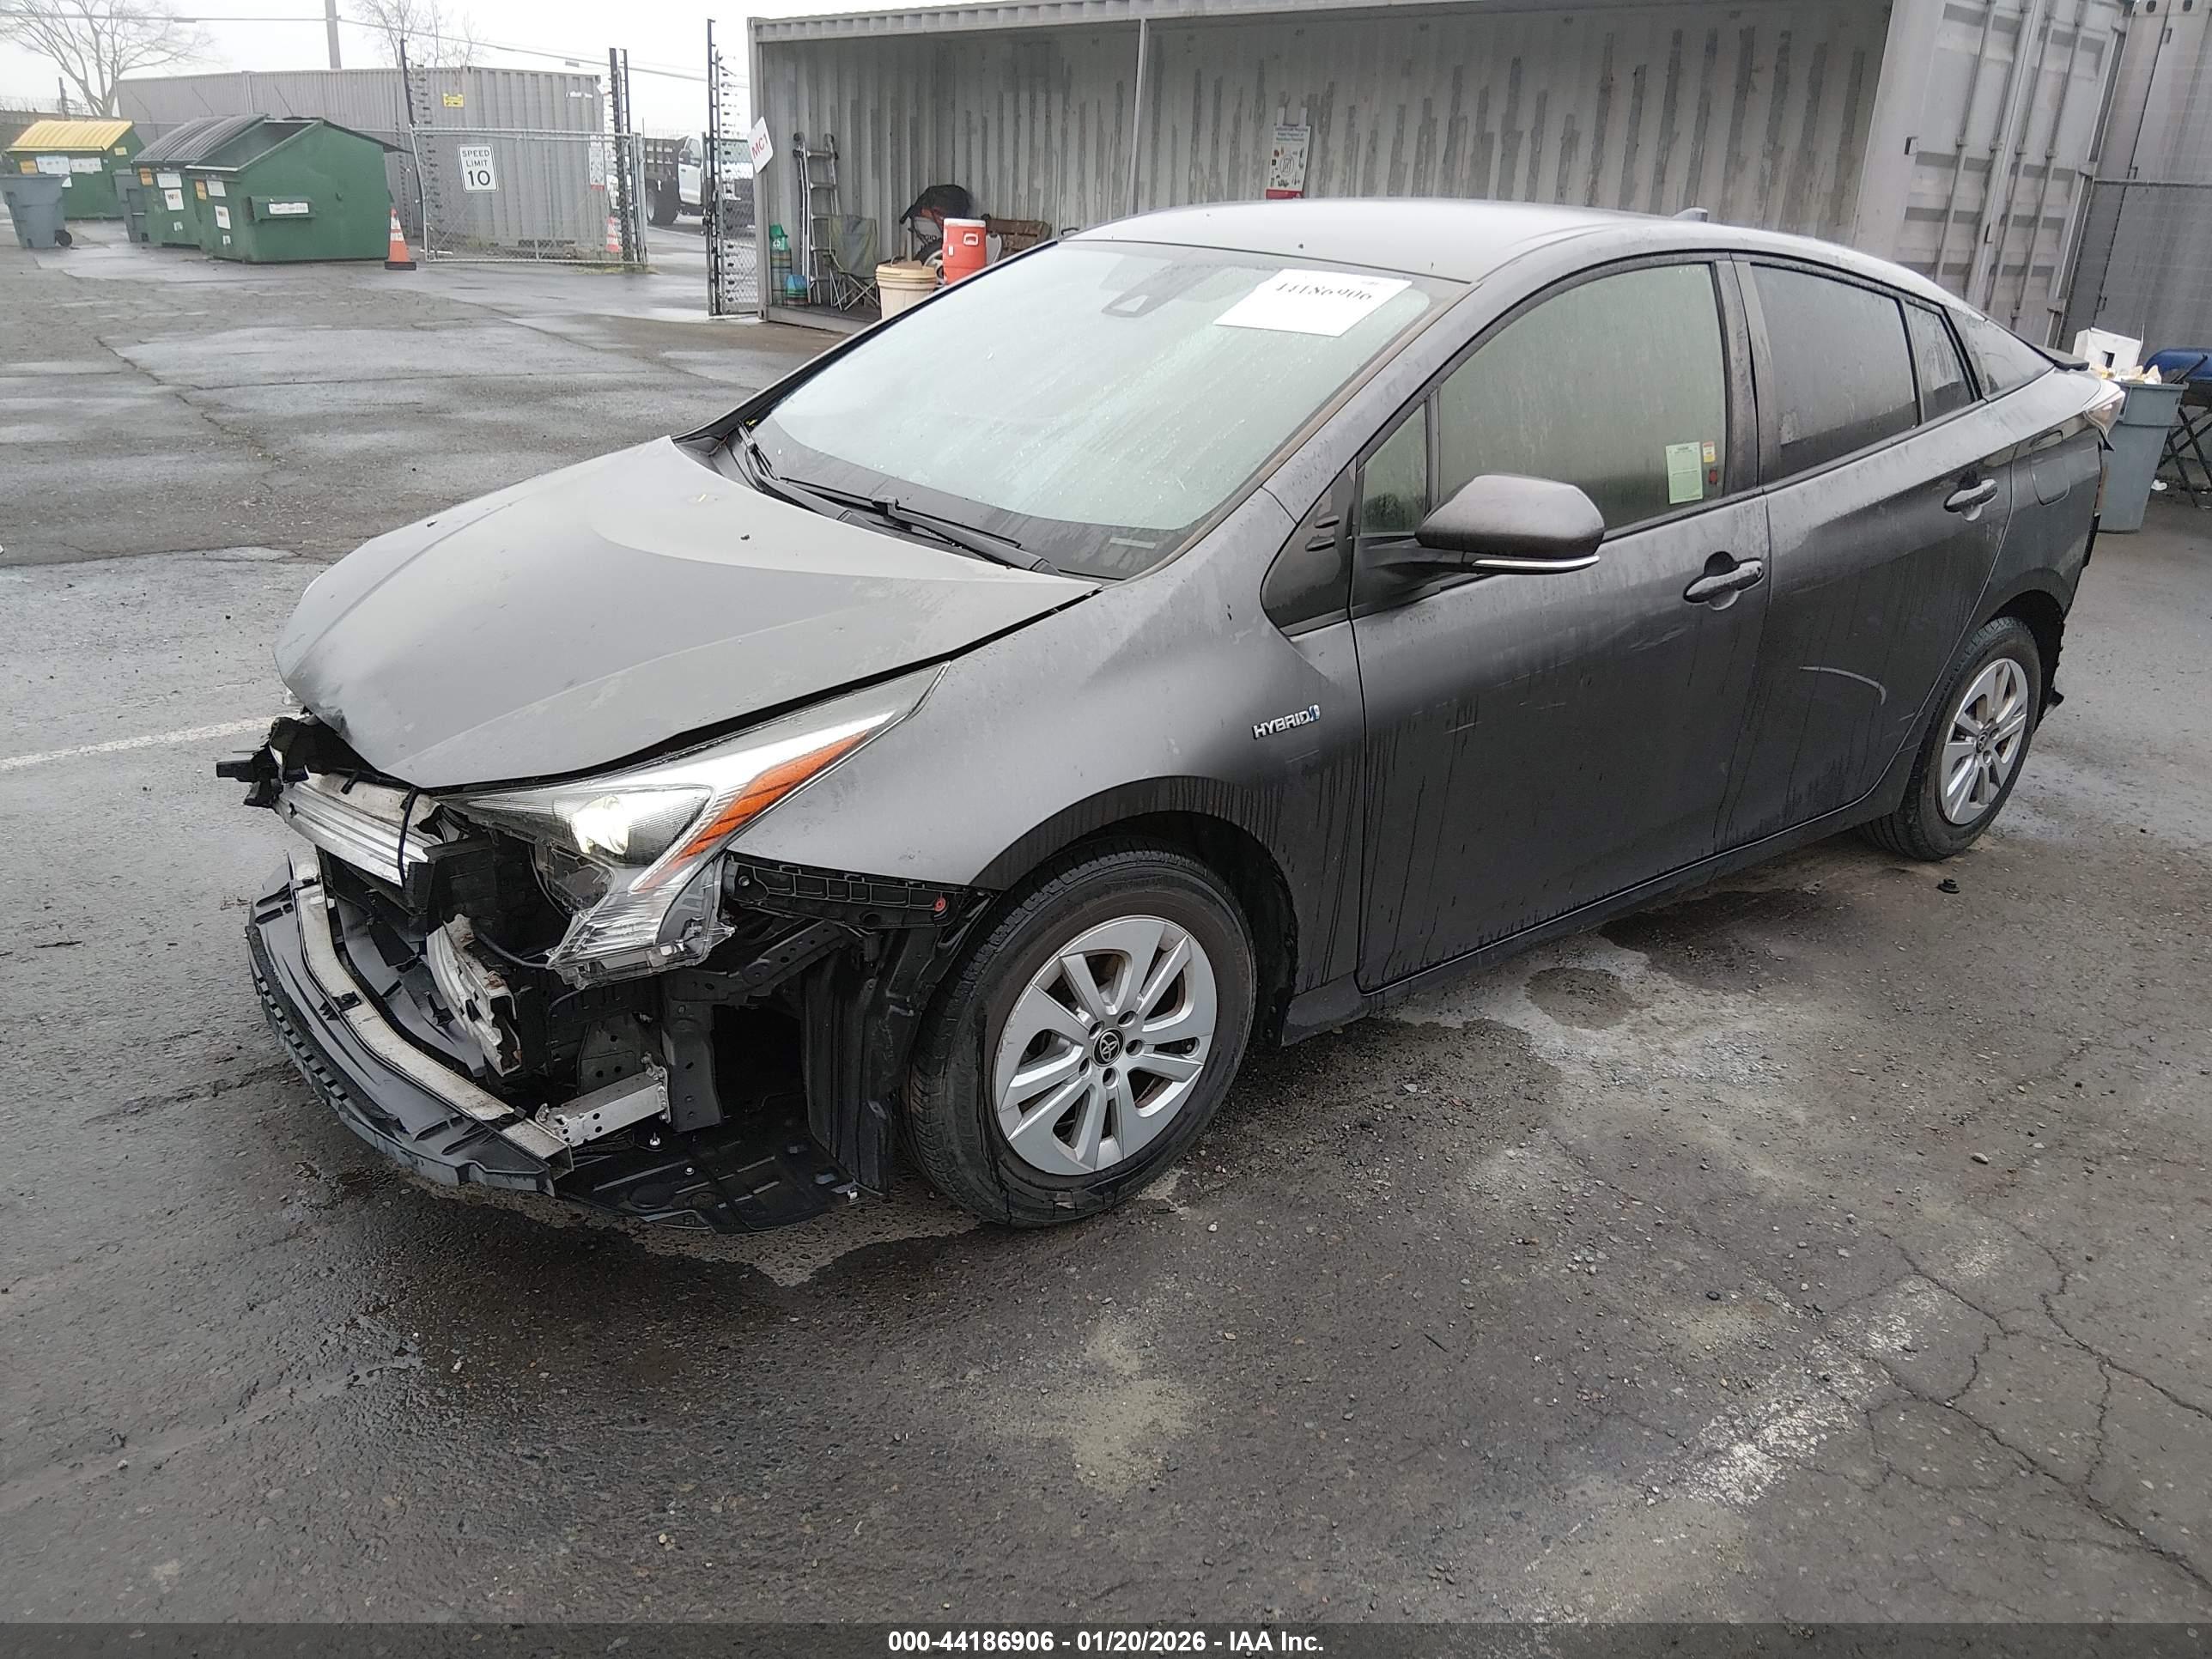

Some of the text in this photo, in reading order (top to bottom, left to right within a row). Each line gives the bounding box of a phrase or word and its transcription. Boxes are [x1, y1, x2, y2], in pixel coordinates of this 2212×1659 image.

[462, 149, 490, 158] SPEED
[751, 132, 769, 159] MC1
[468, 170, 491, 186] 10
[1253, 710, 1311, 740] HYBRID
